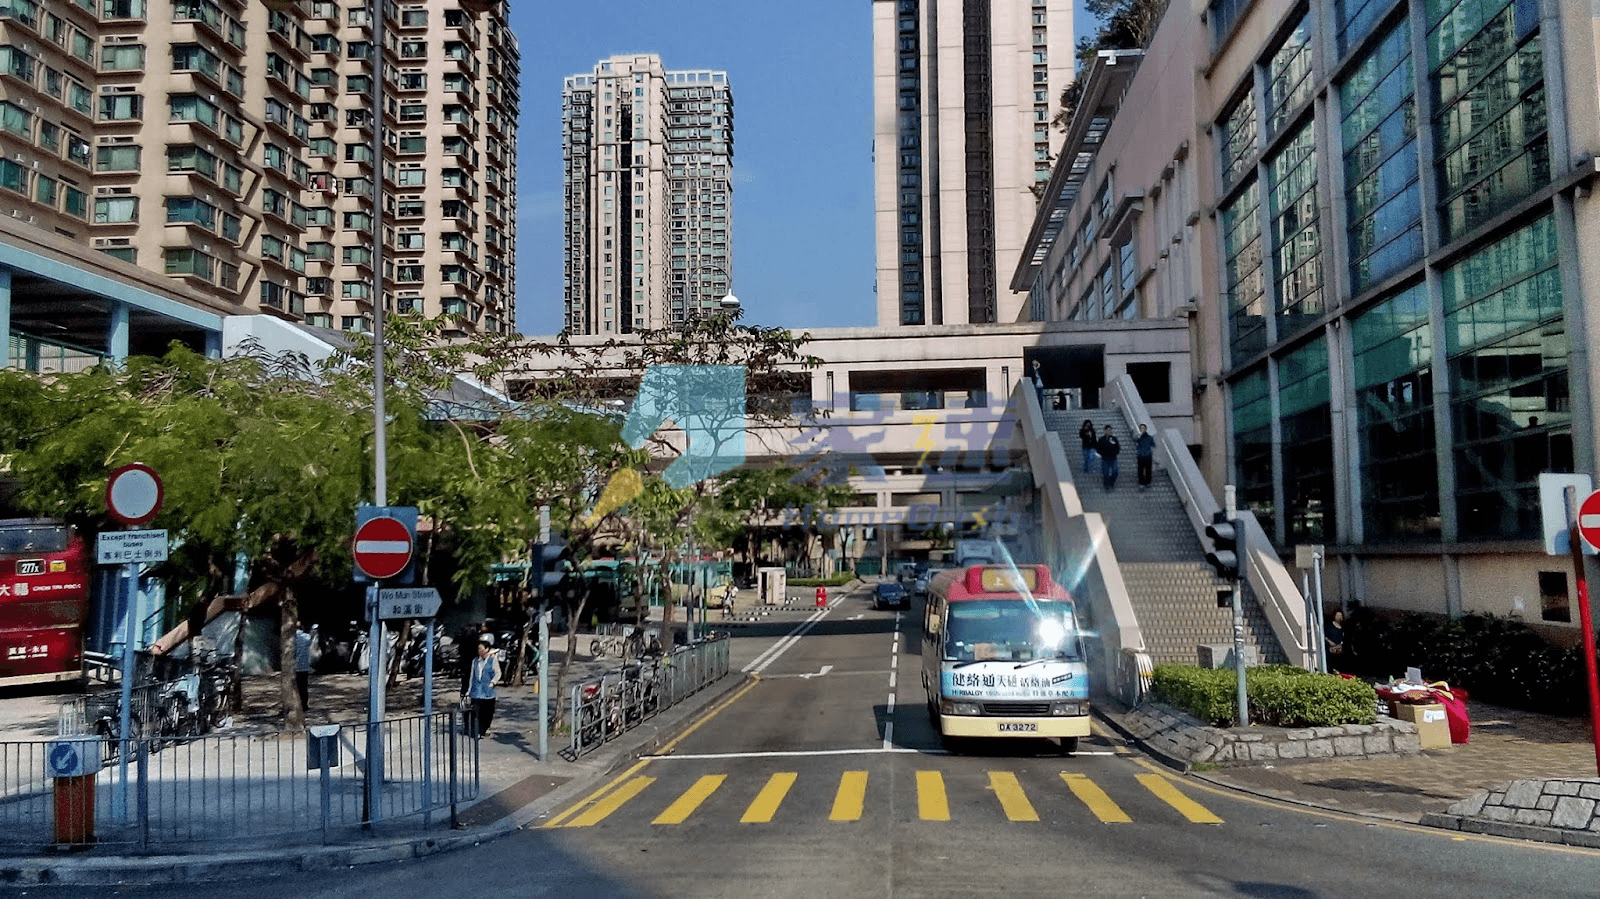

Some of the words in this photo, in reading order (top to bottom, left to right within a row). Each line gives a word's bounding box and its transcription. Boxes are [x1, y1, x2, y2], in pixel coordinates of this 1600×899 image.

[128, 531, 165, 540] franchised
[381, 591, 394, 600] Wo
[412, 590, 434, 599] Street
[1012, 723, 1037, 732] 3272
